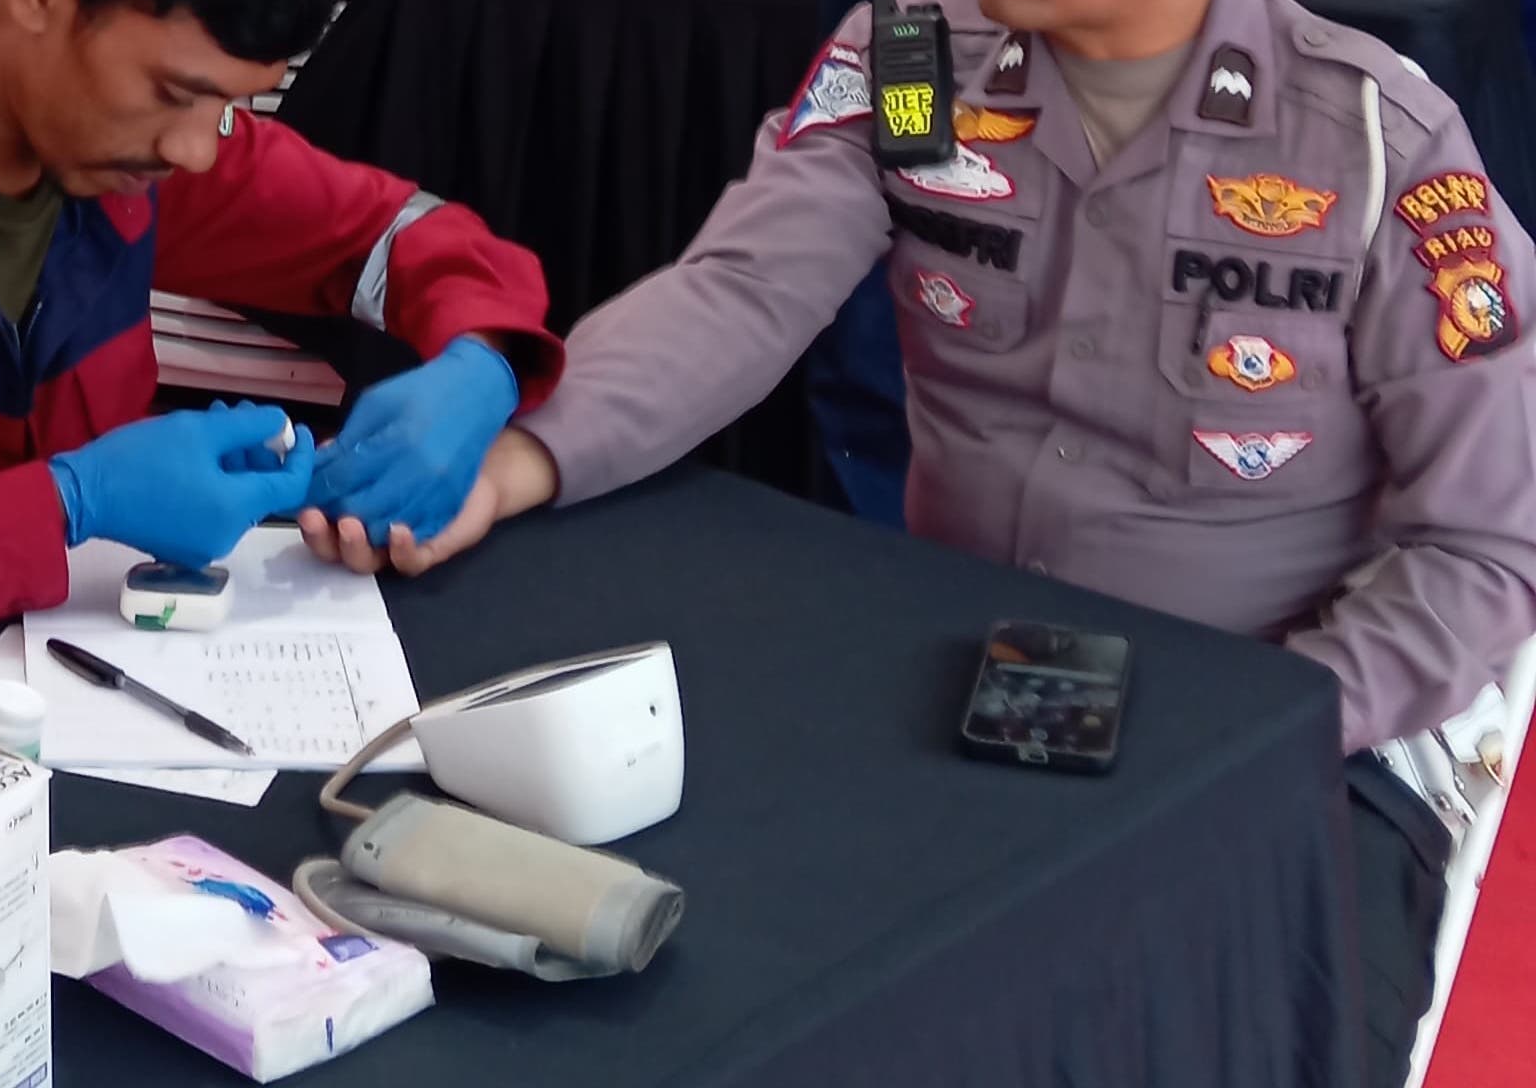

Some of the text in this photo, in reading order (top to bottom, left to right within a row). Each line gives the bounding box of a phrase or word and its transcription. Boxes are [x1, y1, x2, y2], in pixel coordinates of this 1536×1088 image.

[884, 90, 932, 113] DEF
[1425, 226, 1492, 258] RIAU
[1171, 249, 1344, 313] POLRI
